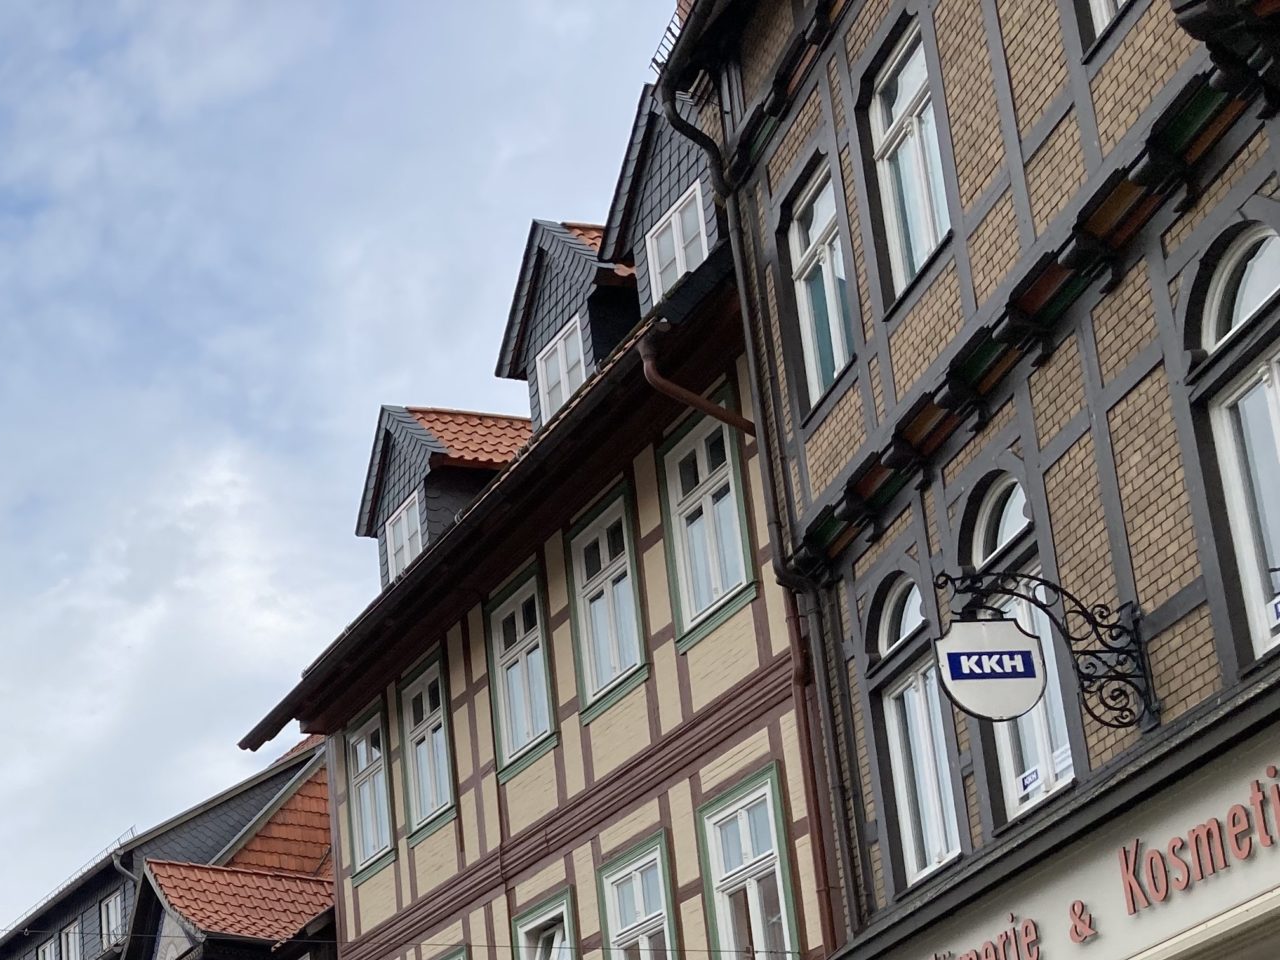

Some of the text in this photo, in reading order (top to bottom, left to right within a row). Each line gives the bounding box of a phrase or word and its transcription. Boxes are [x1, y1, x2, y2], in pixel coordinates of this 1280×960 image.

[960, 654, 1025, 674] KKH
[1024, 770, 1038, 787] KKH
[1069, 899, 1099, 944] &
